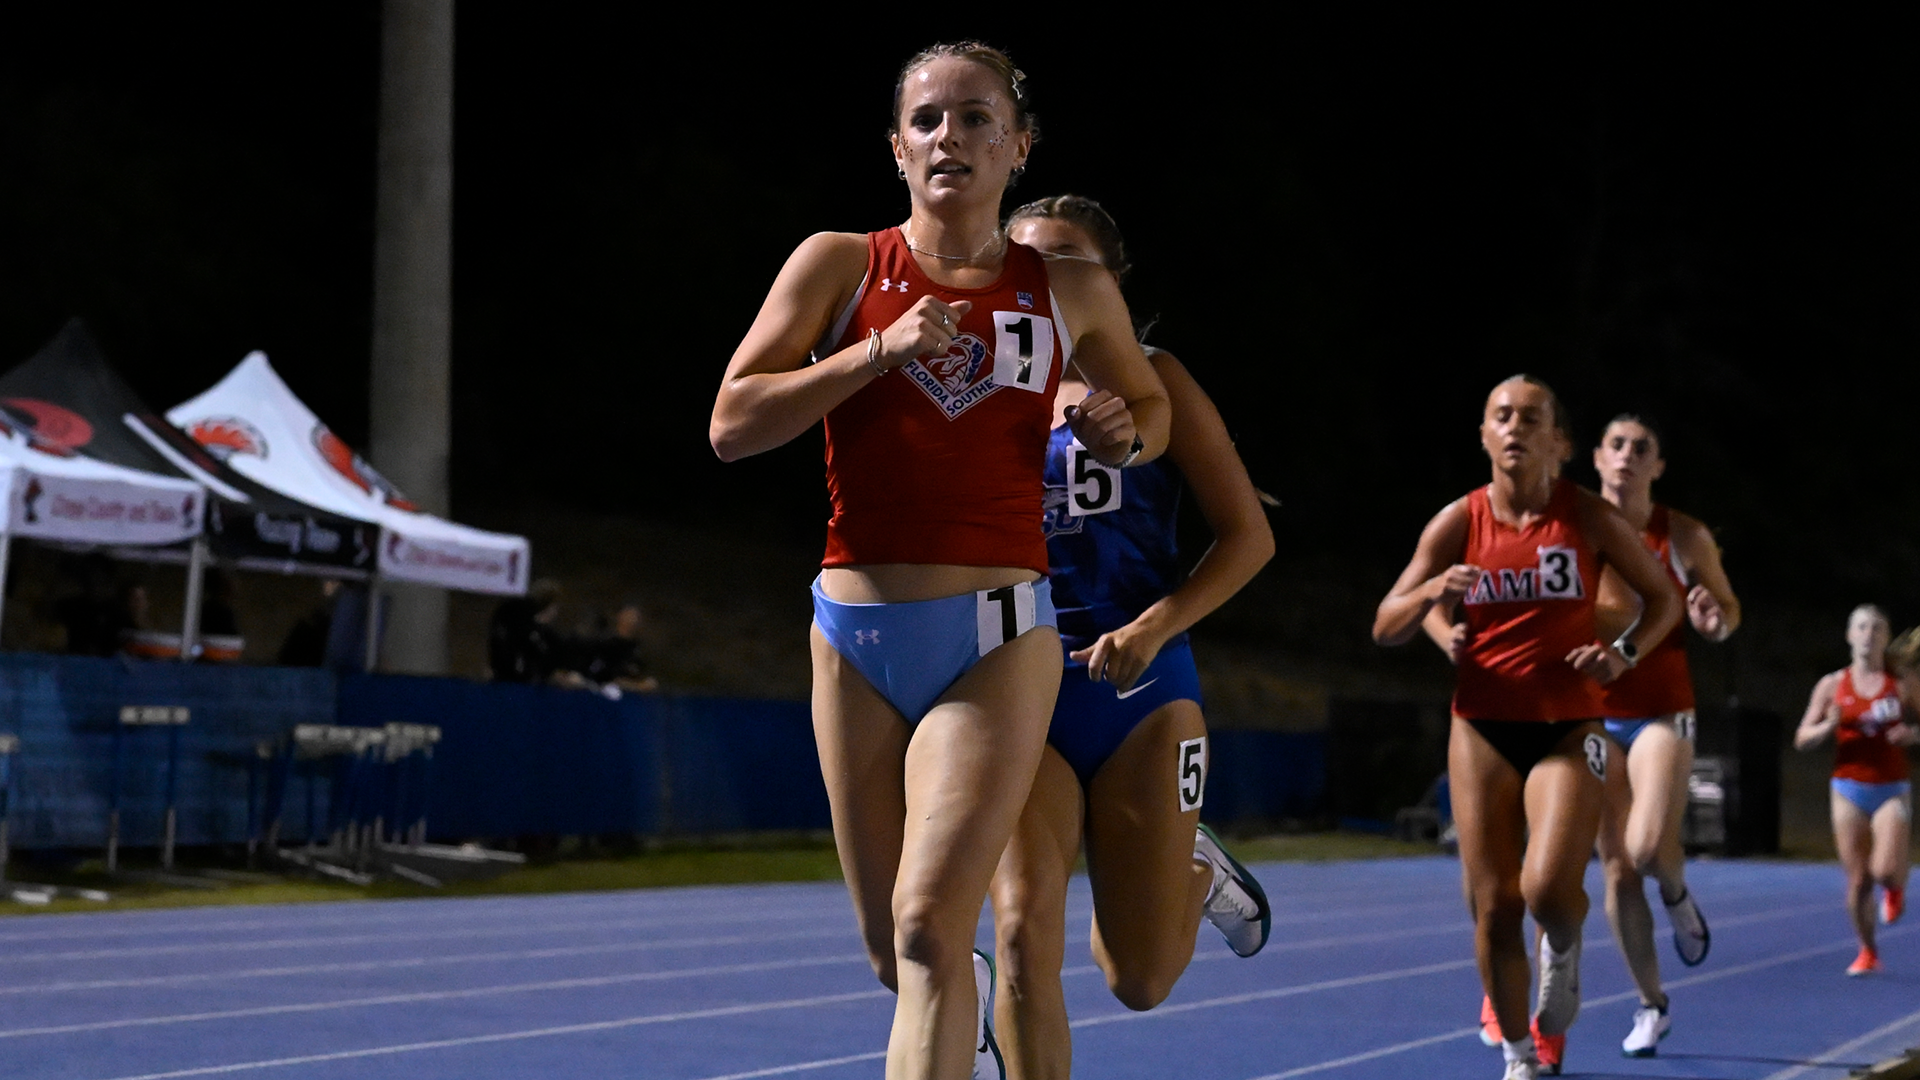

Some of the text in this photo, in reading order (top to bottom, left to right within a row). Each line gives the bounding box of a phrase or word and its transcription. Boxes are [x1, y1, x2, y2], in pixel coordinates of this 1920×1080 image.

[1004, 316, 1033, 385] 1
[904, 361, 950, 405] FLORIDA
[1074, 450, 1112, 510] 5
[1545, 552, 1571, 593] 3
[986, 585, 1018, 645] 1
[1182, 743, 1202, 806] 5
[1588, 737, 1604, 776] 3
